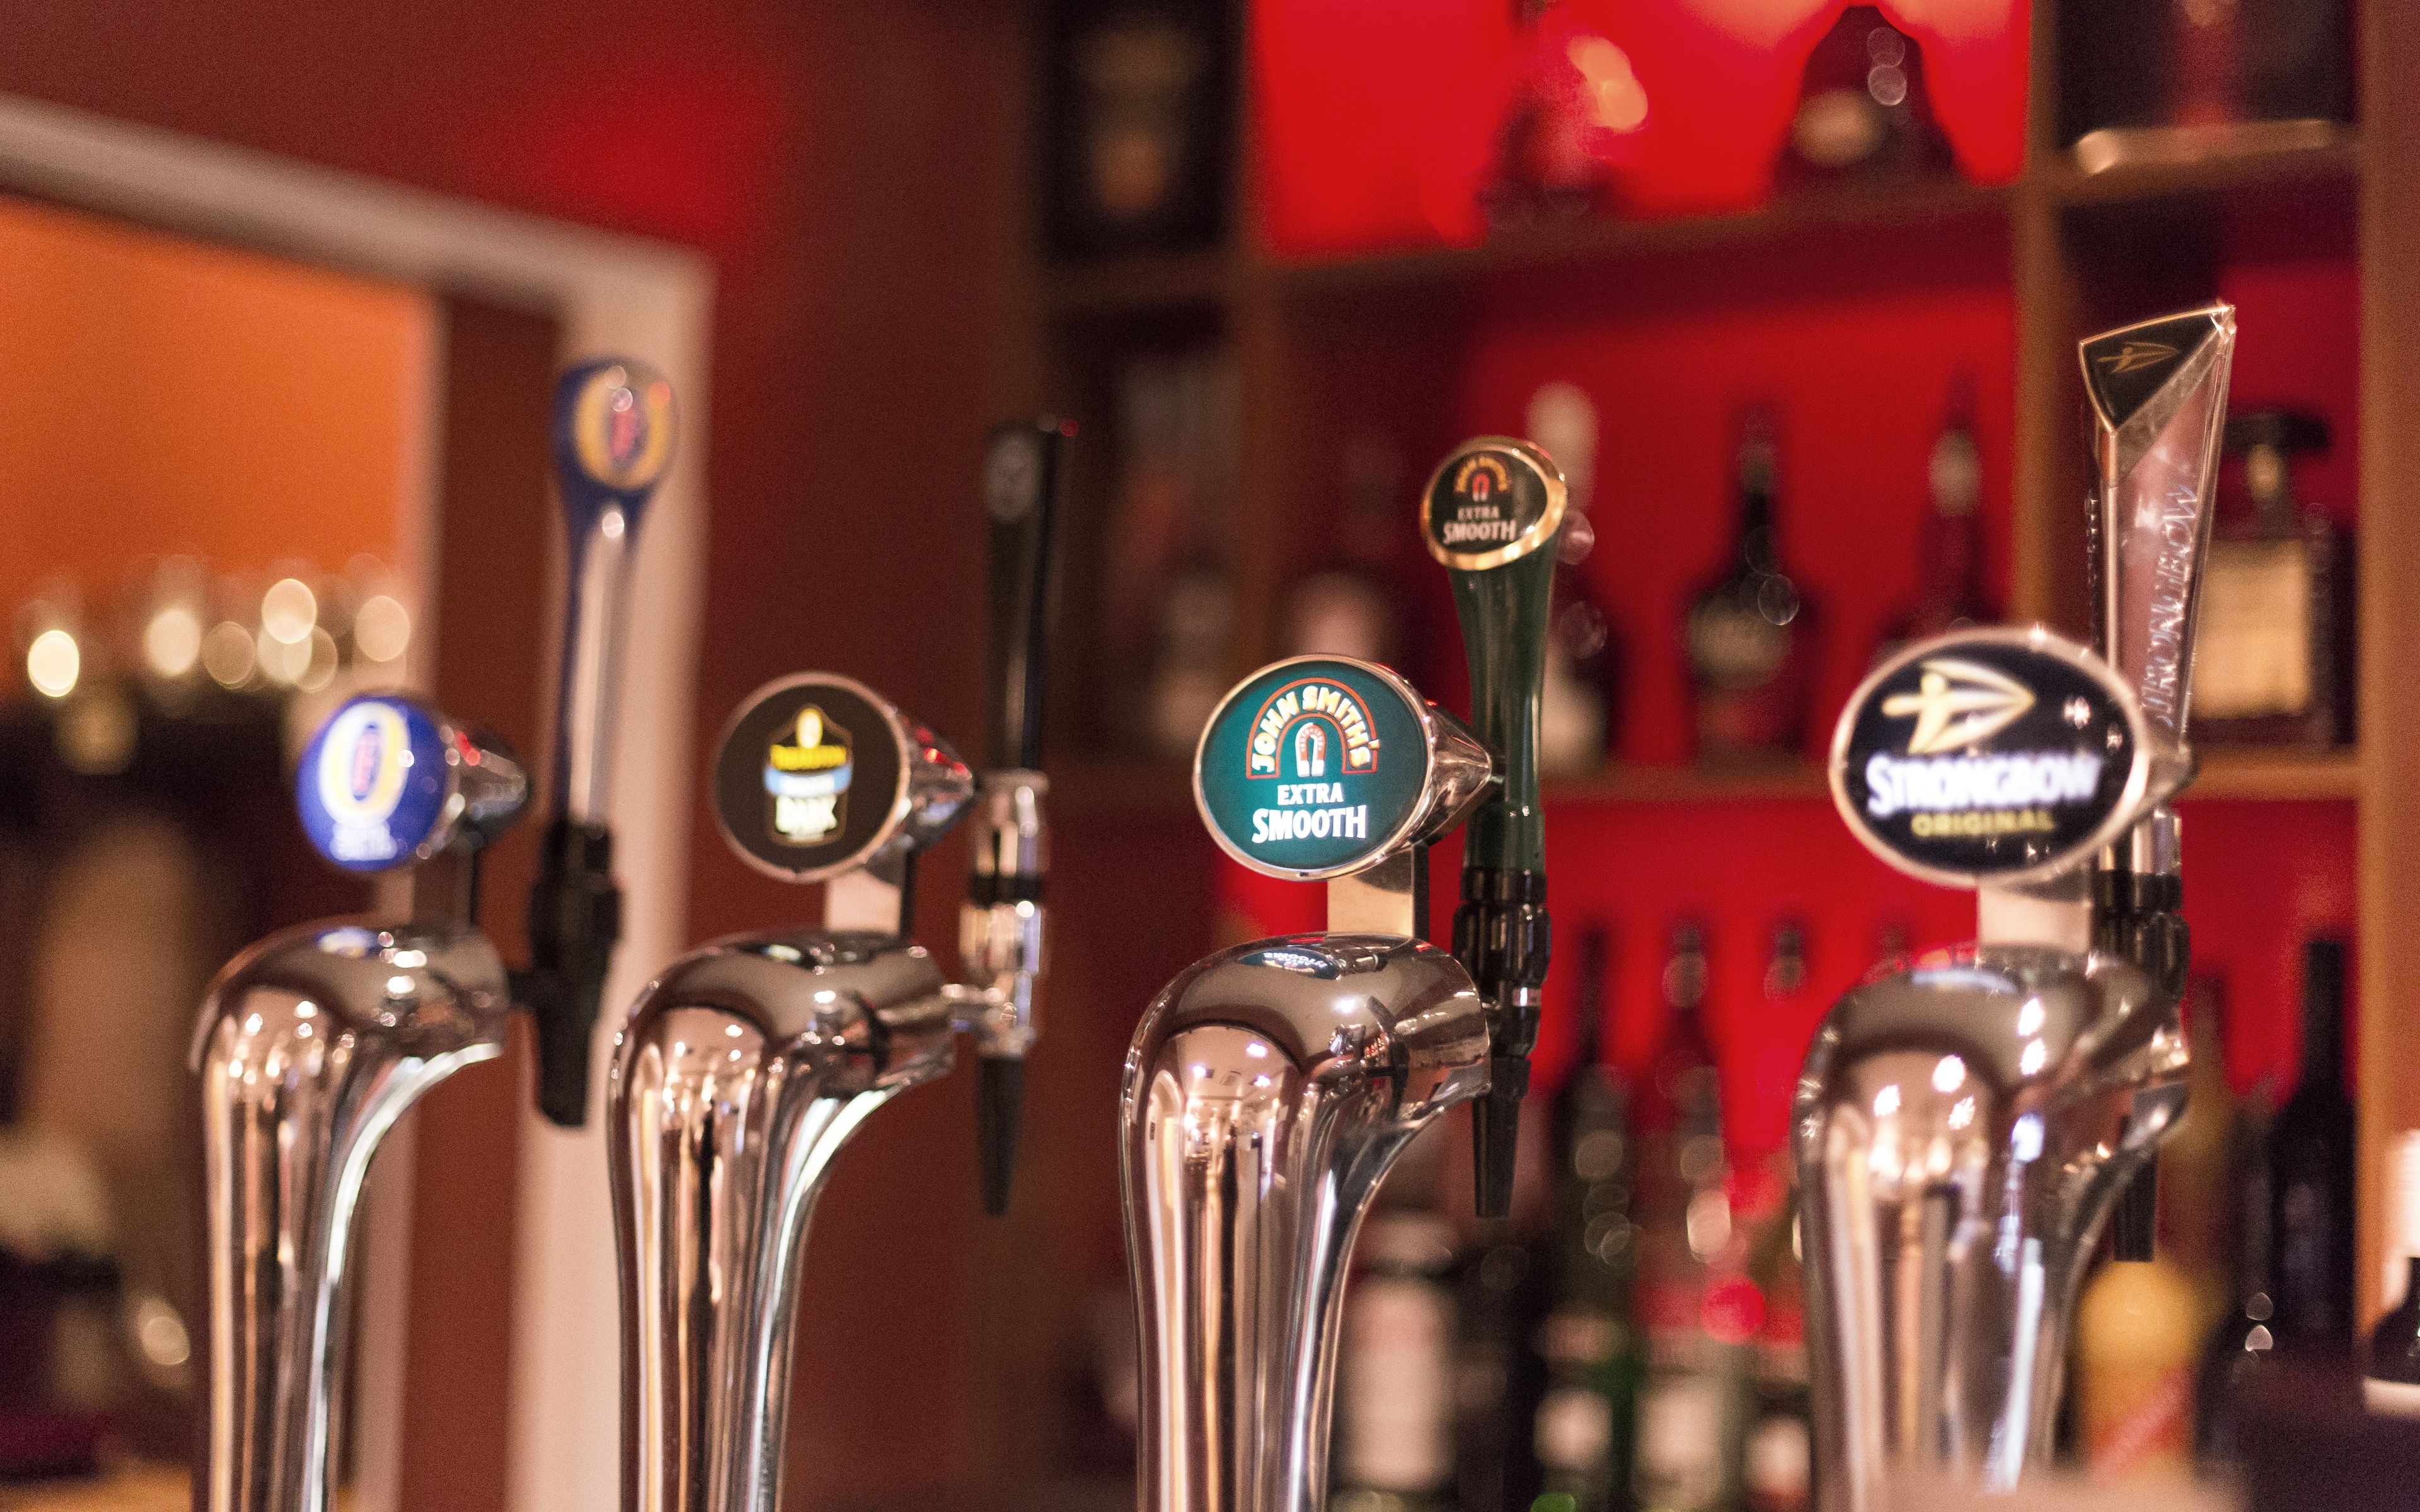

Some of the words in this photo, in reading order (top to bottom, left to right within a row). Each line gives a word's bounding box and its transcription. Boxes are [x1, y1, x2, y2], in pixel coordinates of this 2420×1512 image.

[1443, 518, 1517, 545] SMOOTH
[1252, 690, 1299, 773] JOHN
[1302, 685, 1381, 768] SMITH'S
[1277, 782, 1344, 806] EXTRA
[1252, 805, 1368, 844] SMOOTH
